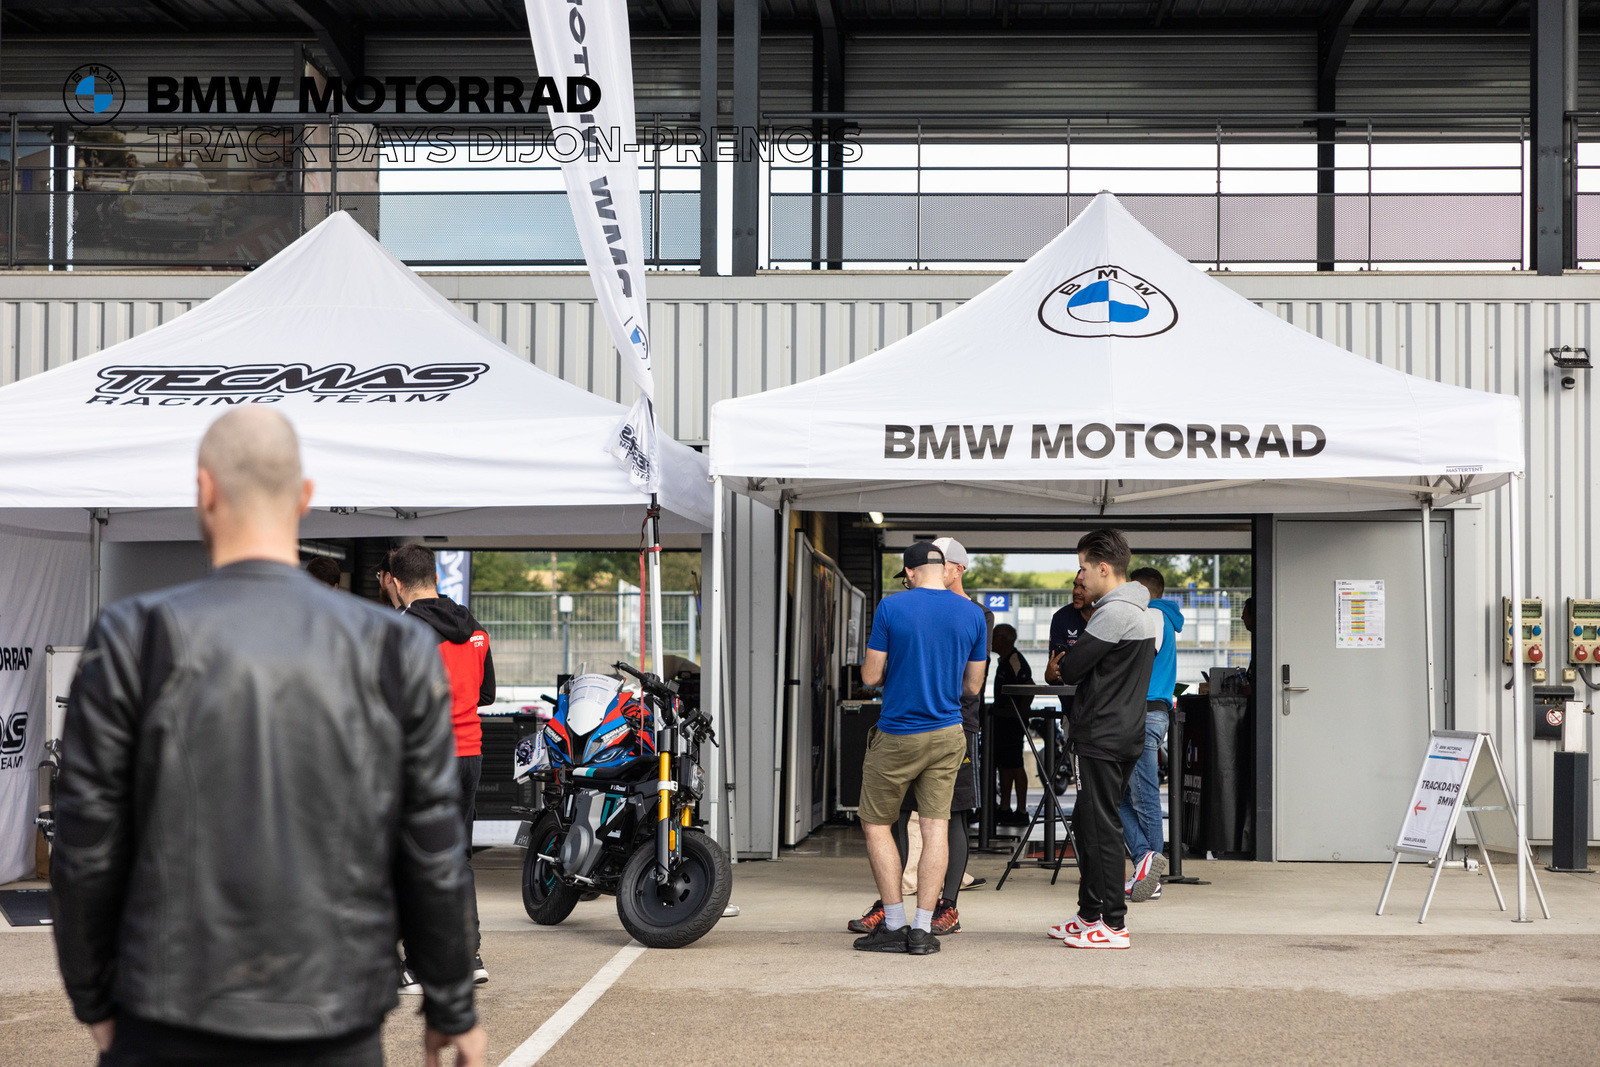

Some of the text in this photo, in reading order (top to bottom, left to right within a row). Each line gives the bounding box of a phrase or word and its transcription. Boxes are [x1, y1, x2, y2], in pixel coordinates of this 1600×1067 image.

[1059, 269, 1157, 296] BMW
[86, 393, 451, 406] RACING TEAM
[884, 422, 1327, 460] BMW MOTORRAD
[990, 596, 1005, 607] 22
[1421, 780, 1461, 793] TRACKDAYS
[1437, 796, 1457, 806] BMW
